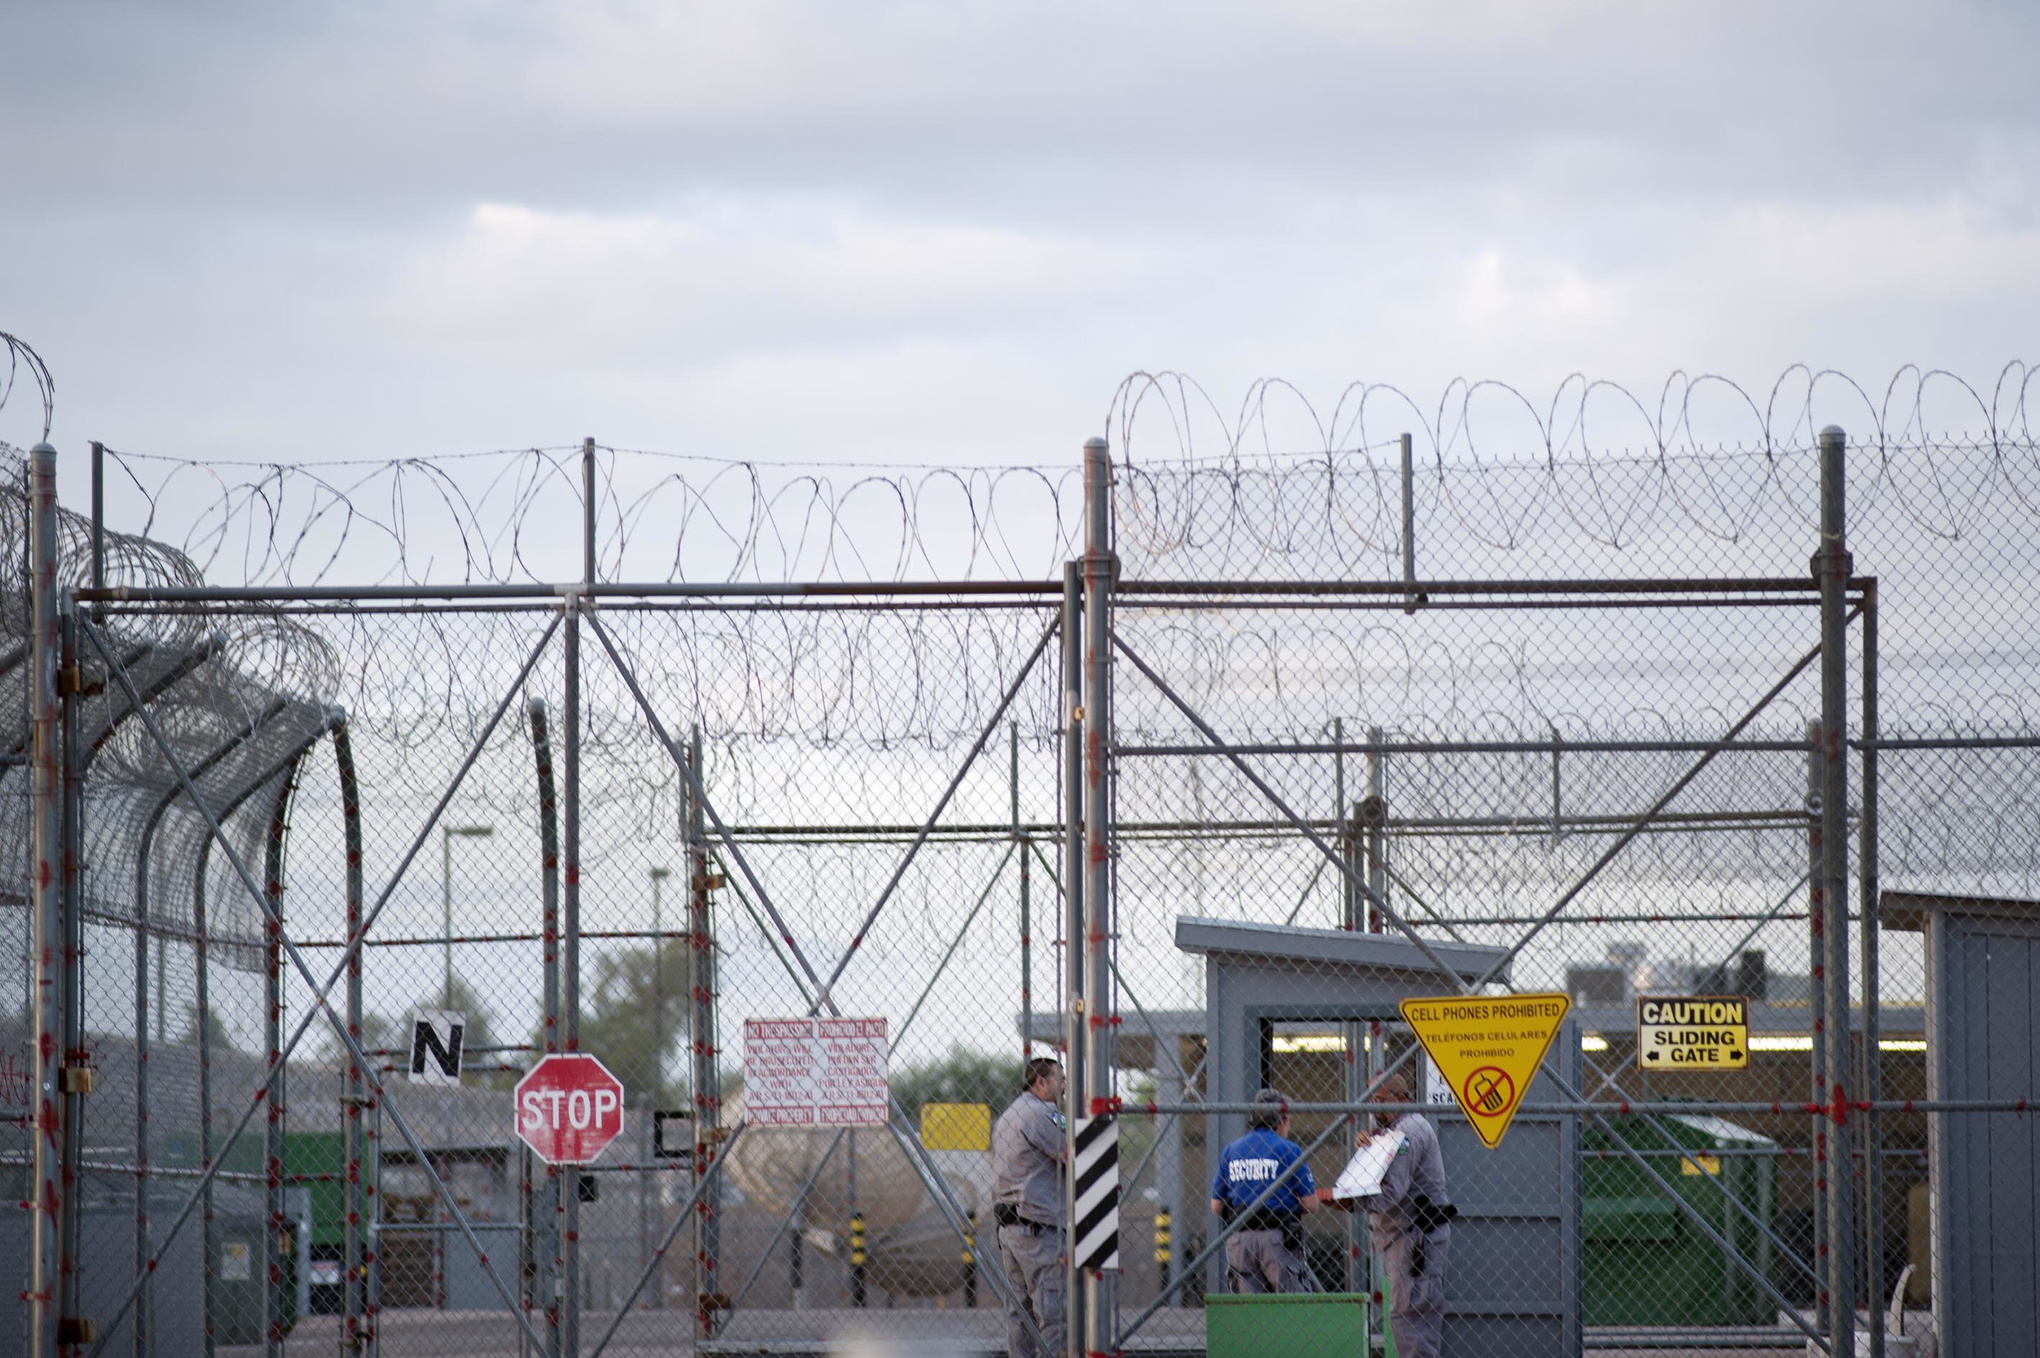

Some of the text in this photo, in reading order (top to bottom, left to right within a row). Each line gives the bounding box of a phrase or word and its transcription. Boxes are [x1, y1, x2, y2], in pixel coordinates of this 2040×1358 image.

[1411, 1003, 1560, 1021] CELL PHONES PROHIBITED
[1642, 1002, 1743, 1024] CAUTION
[748, 1023, 758, 1038] NO
[1425, 1029, 1547, 1043] TELÉFONOS CELULARES
[1654, 1031, 1735, 1046] SLIDING
[412, 1020, 464, 1077] N
[793, 1044, 811, 1053] WILL
[1459, 1048, 1515, 1059] PROHIBIDO
[1671, 1048, 1719, 1062] GATE
[760, 1056, 813, 1065] PROSECUTED
[770, 1080, 791, 1088] WITH
[522, 1089, 617, 1130] STOP
[1228, 1158, 1279, 1182] SECURITY
